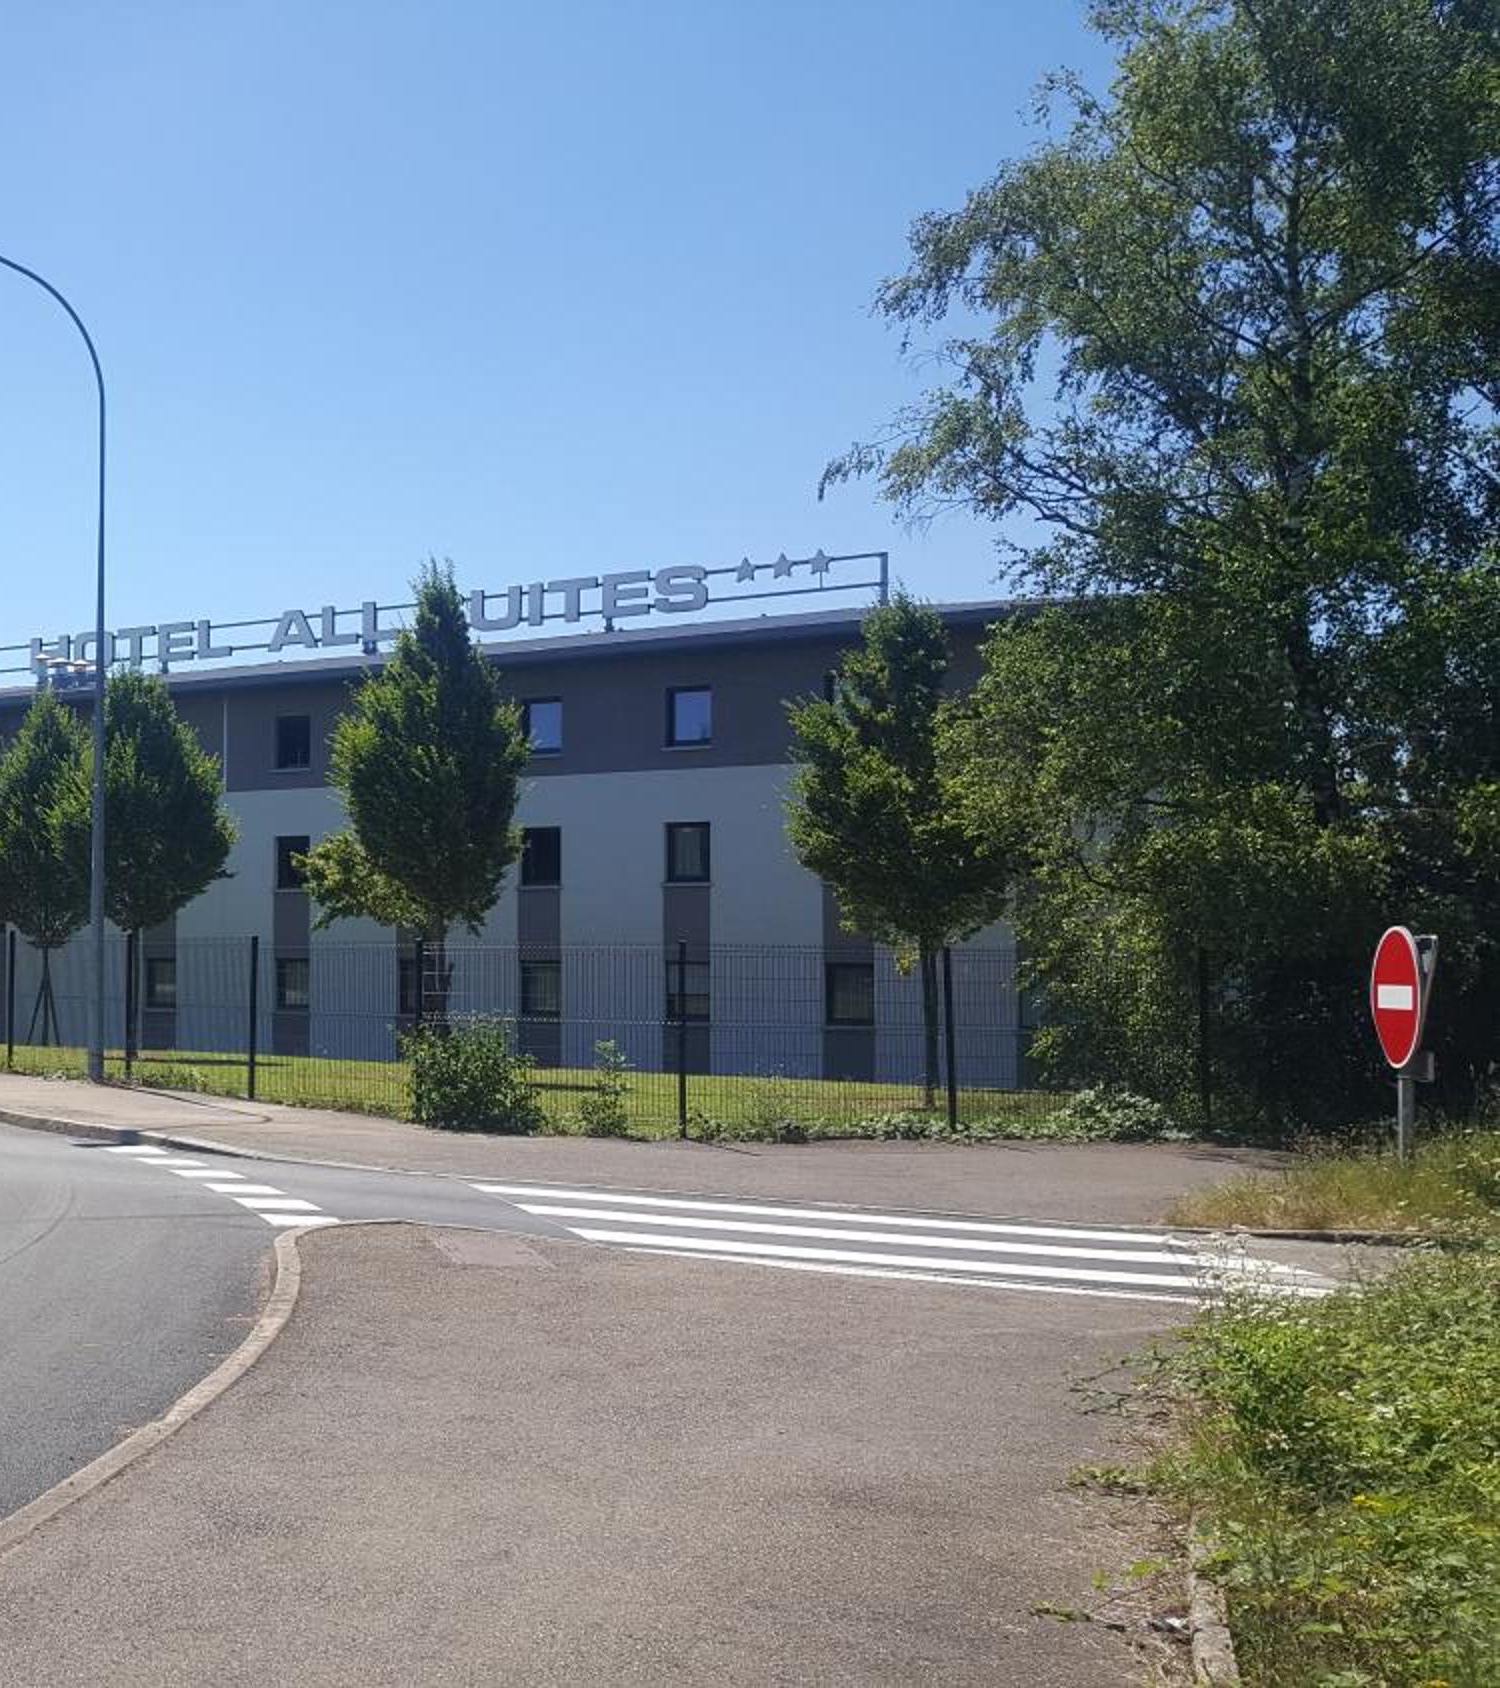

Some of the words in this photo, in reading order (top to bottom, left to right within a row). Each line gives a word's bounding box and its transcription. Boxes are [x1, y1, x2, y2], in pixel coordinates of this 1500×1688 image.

[30, 619, 232, 674] HOTEL
[268, 601, 400, 653] ALL
[468, 565, 708, 632] UITES
